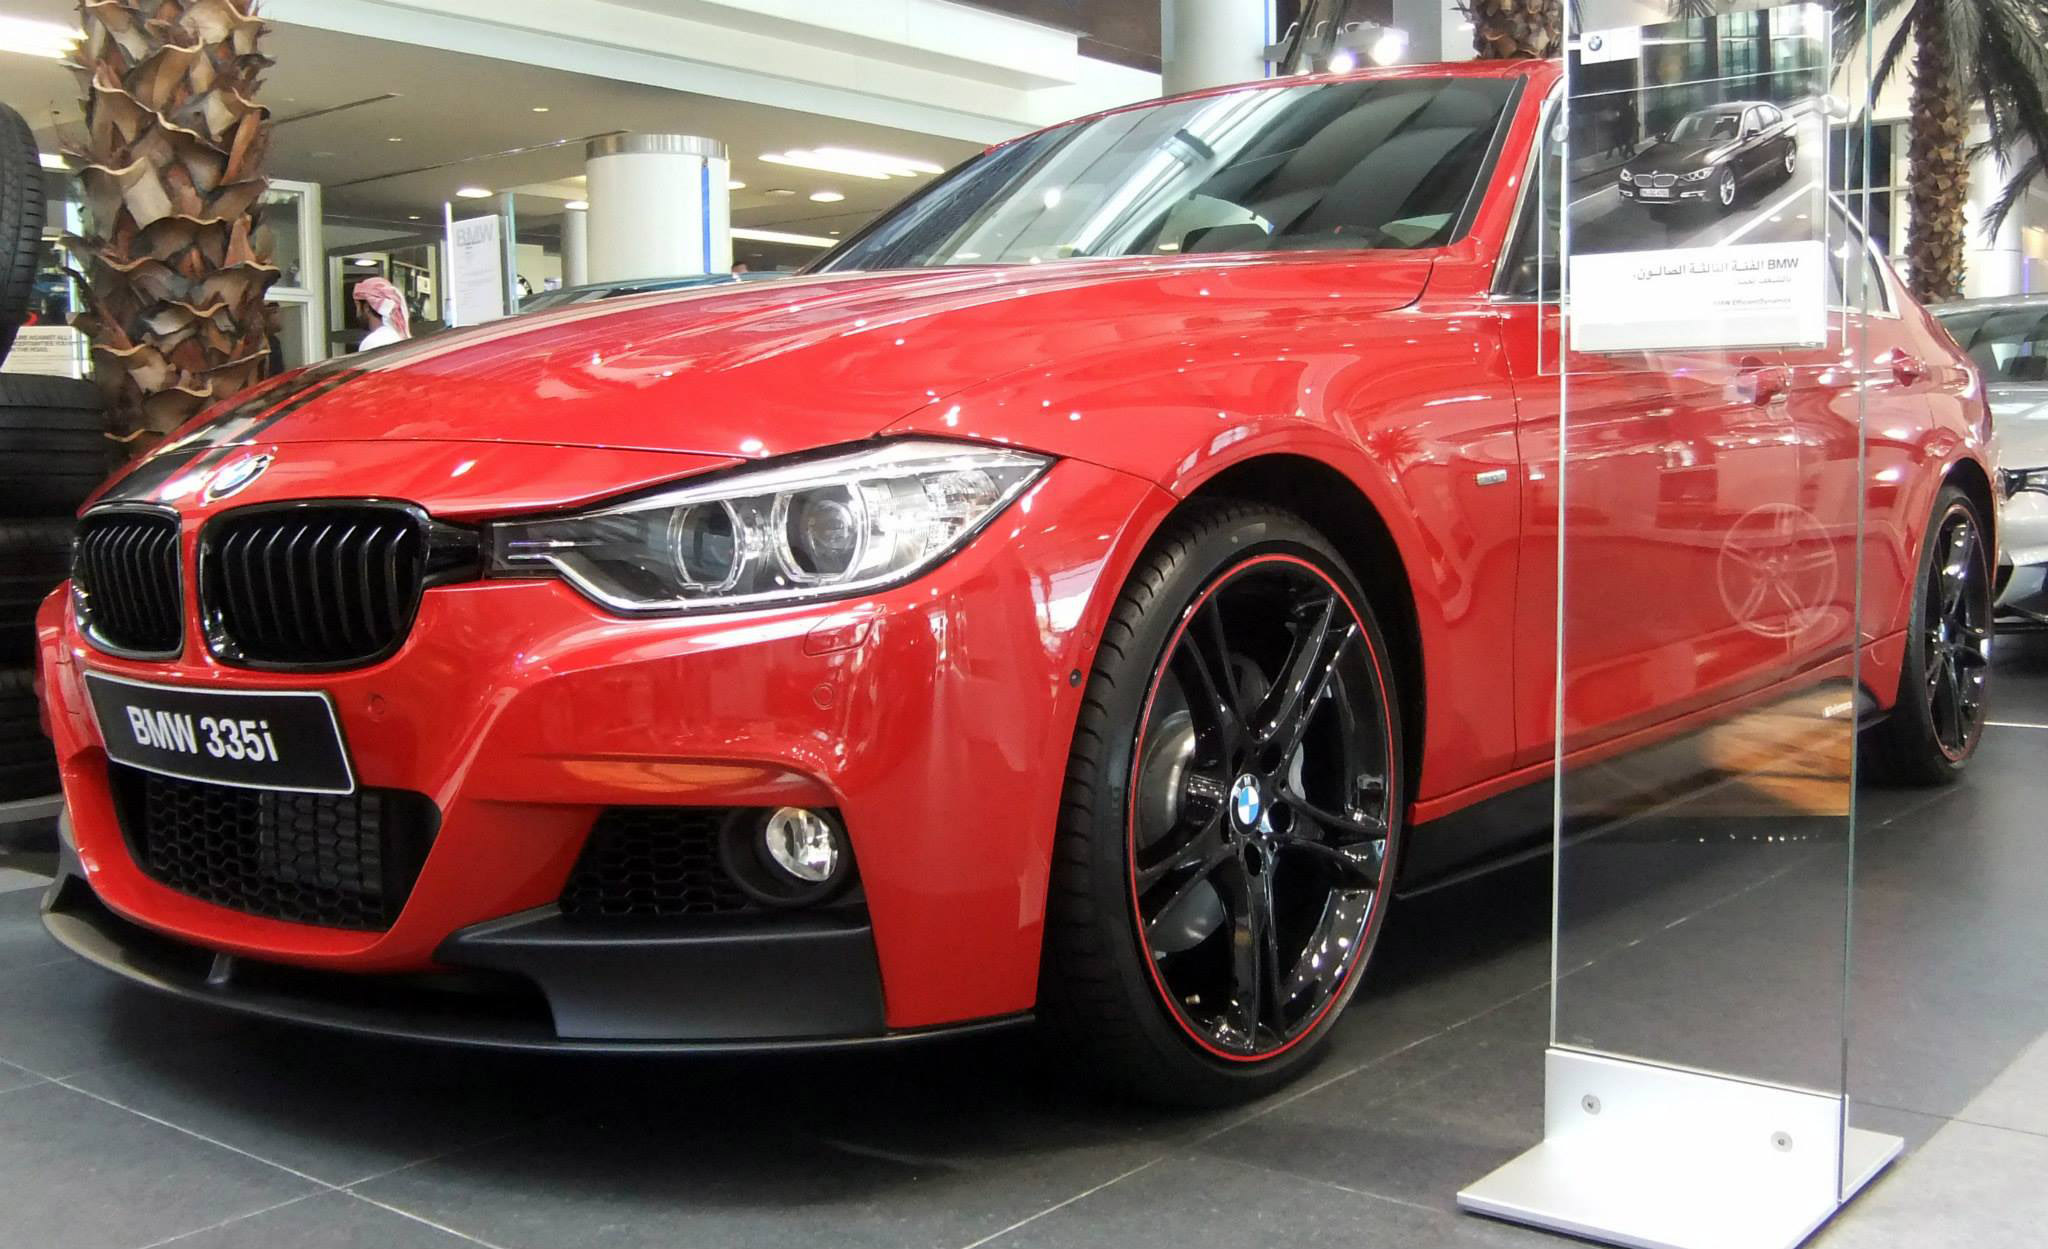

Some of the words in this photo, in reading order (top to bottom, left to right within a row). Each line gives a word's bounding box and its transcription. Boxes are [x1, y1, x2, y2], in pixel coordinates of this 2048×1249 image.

[1767, 258, 1799, 270] BMW
[126, 705, 197, 753] BMW
[200, 716, 278, 762] 335i
